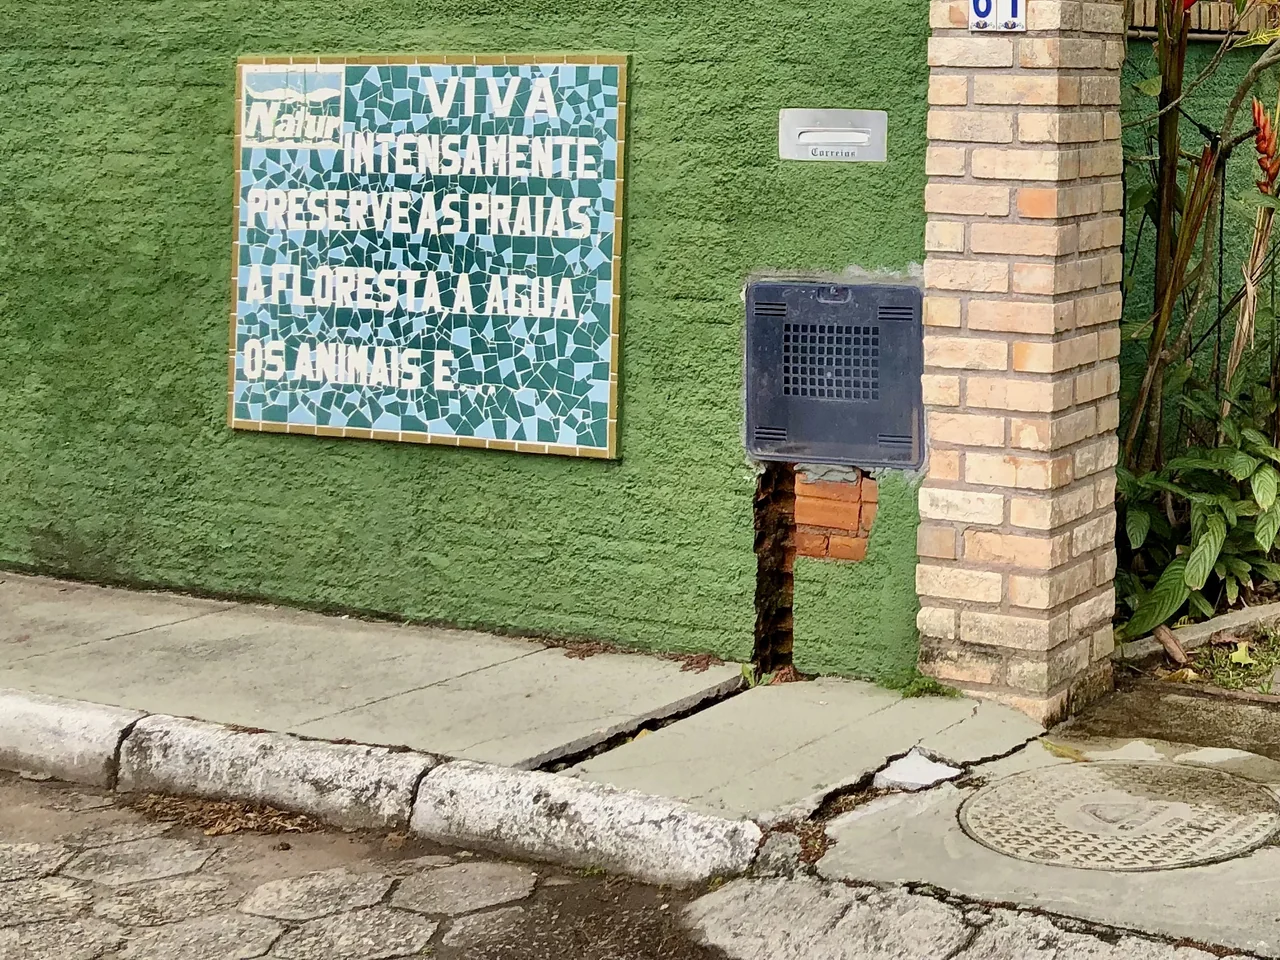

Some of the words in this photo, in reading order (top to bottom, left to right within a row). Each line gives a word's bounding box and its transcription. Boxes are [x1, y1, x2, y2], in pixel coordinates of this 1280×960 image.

[246, 101, 341, 138] Natur
[424, 76, 558, 118] VIVA
[343, 131, 599, 179] INTENSAMENTE
[811, 147, 856, 158] Correios
[247, 187, 412, 233] PRESERVE
[416, 191, 462, 234] AS
[246, 263, 265, 305] A
[453, 272, 475, 315] A
[243, 338, 286, 381] OS
[294, 341, 422, 390] ANIMAIS
